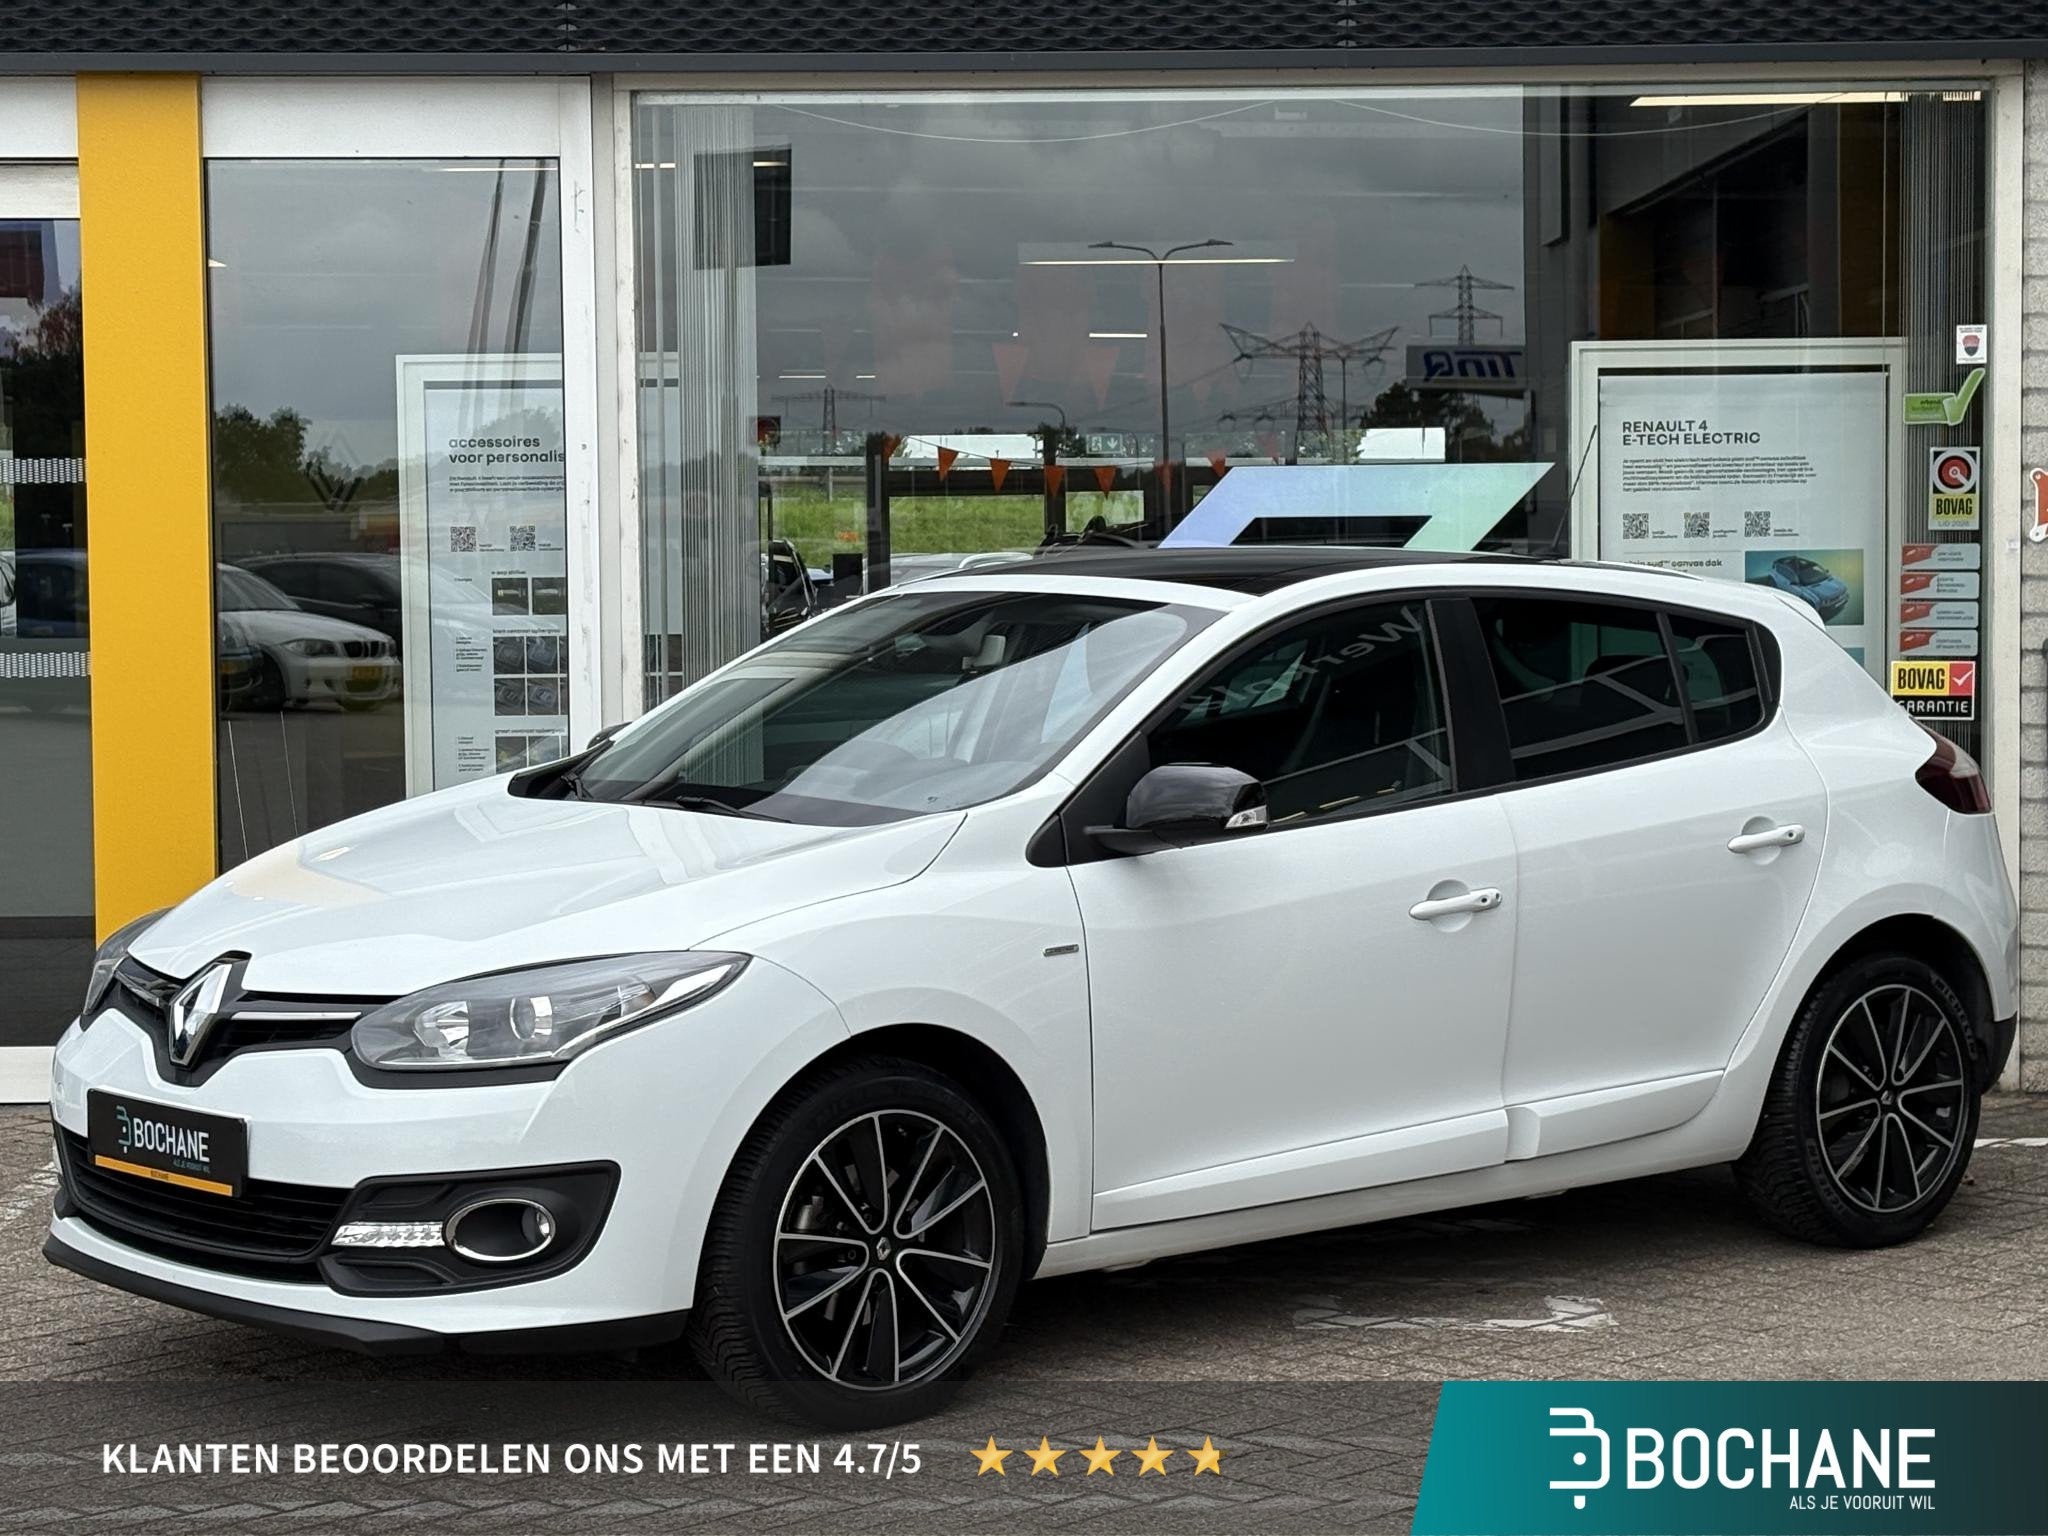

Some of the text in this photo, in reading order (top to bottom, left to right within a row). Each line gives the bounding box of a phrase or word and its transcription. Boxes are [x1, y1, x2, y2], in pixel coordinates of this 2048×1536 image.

[1622, 419, 1708, 433] RENAULT 4
[448, 435, 541, 448] accessoires
[1622, 432, 1760, 446] E-TECH ELECTRIC
[448, 449, 565, 466] voor personalis
[1935, 498, 1973, 516] BOVAG
[1671, 560, 1704, 568] canvas
[1705, 559, 1722, 568] dak
[1897, 667, 1946, 690] BOVAG
[133, 1117, 210, 1163] BOCHANE
